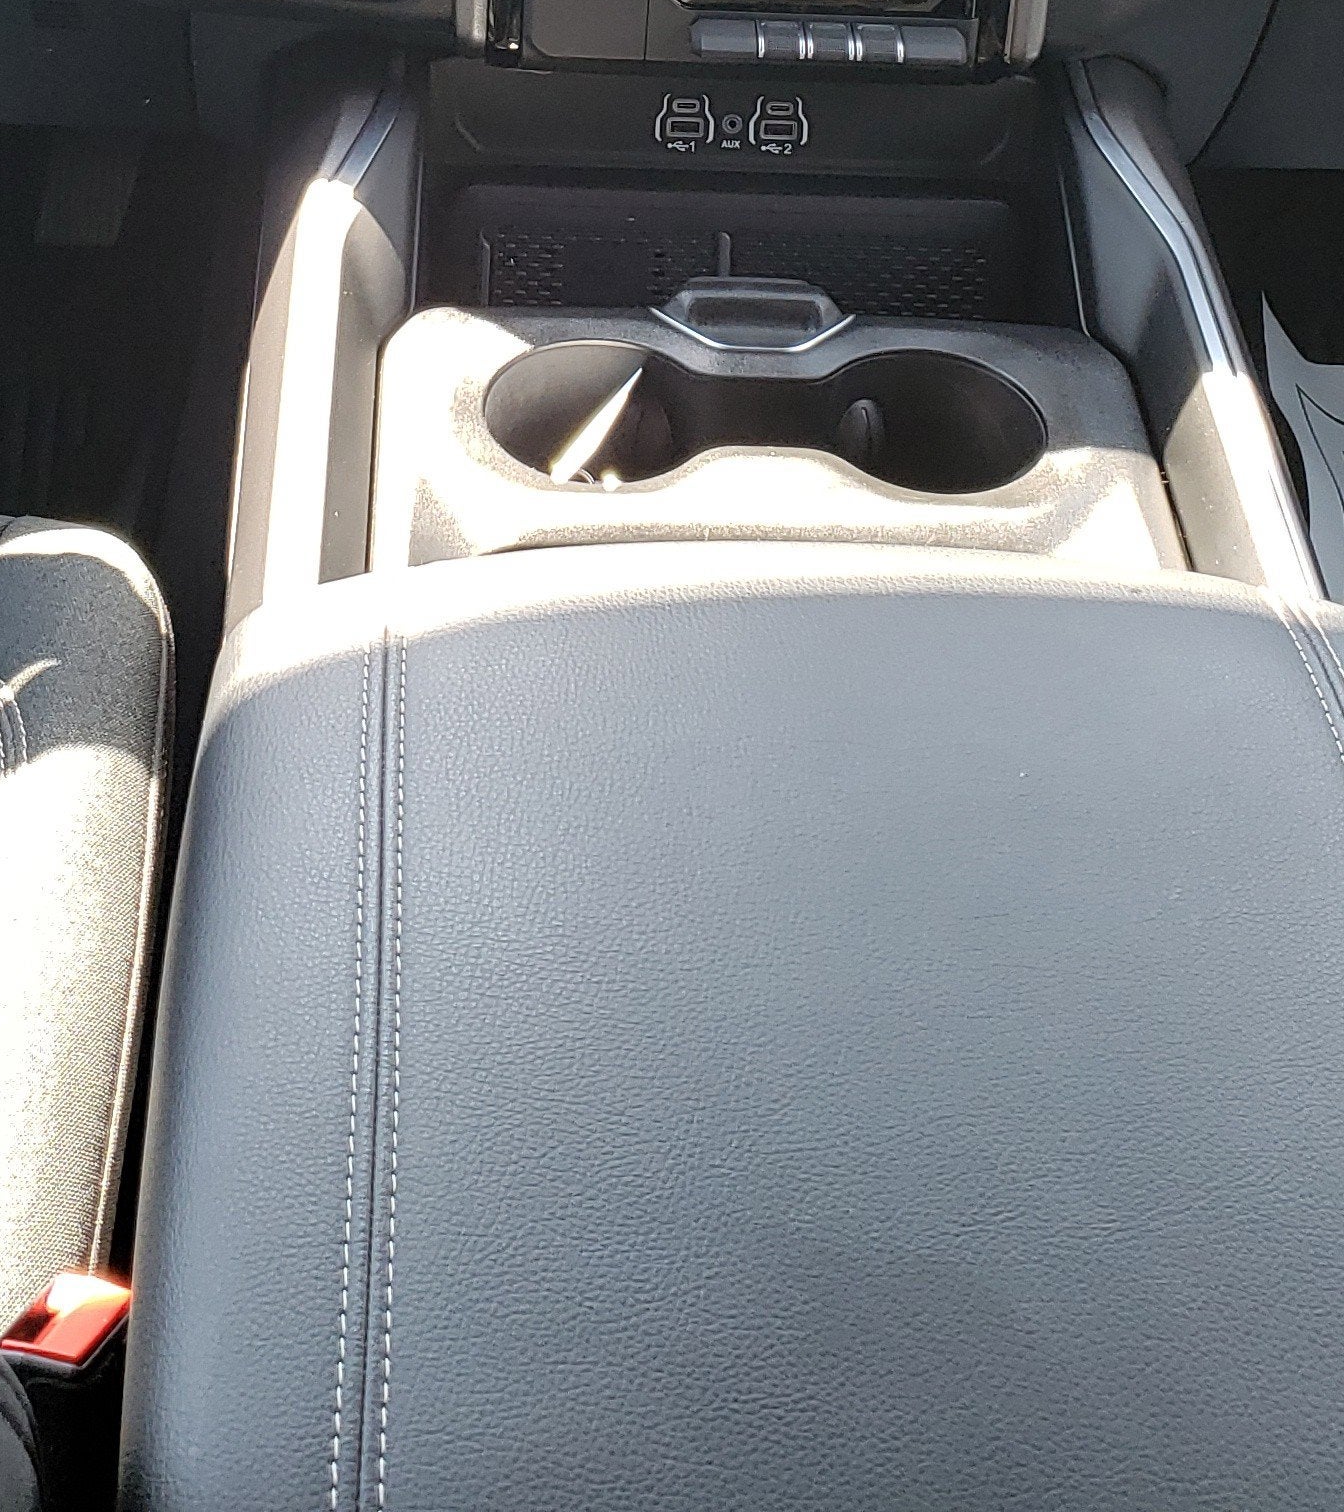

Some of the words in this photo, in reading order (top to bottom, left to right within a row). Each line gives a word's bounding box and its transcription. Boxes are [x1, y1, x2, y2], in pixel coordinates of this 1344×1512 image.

[689, 142, 696, 153] 1
[721, 140, 741, 149] AUX
[783, 143, 793, 155] 2
